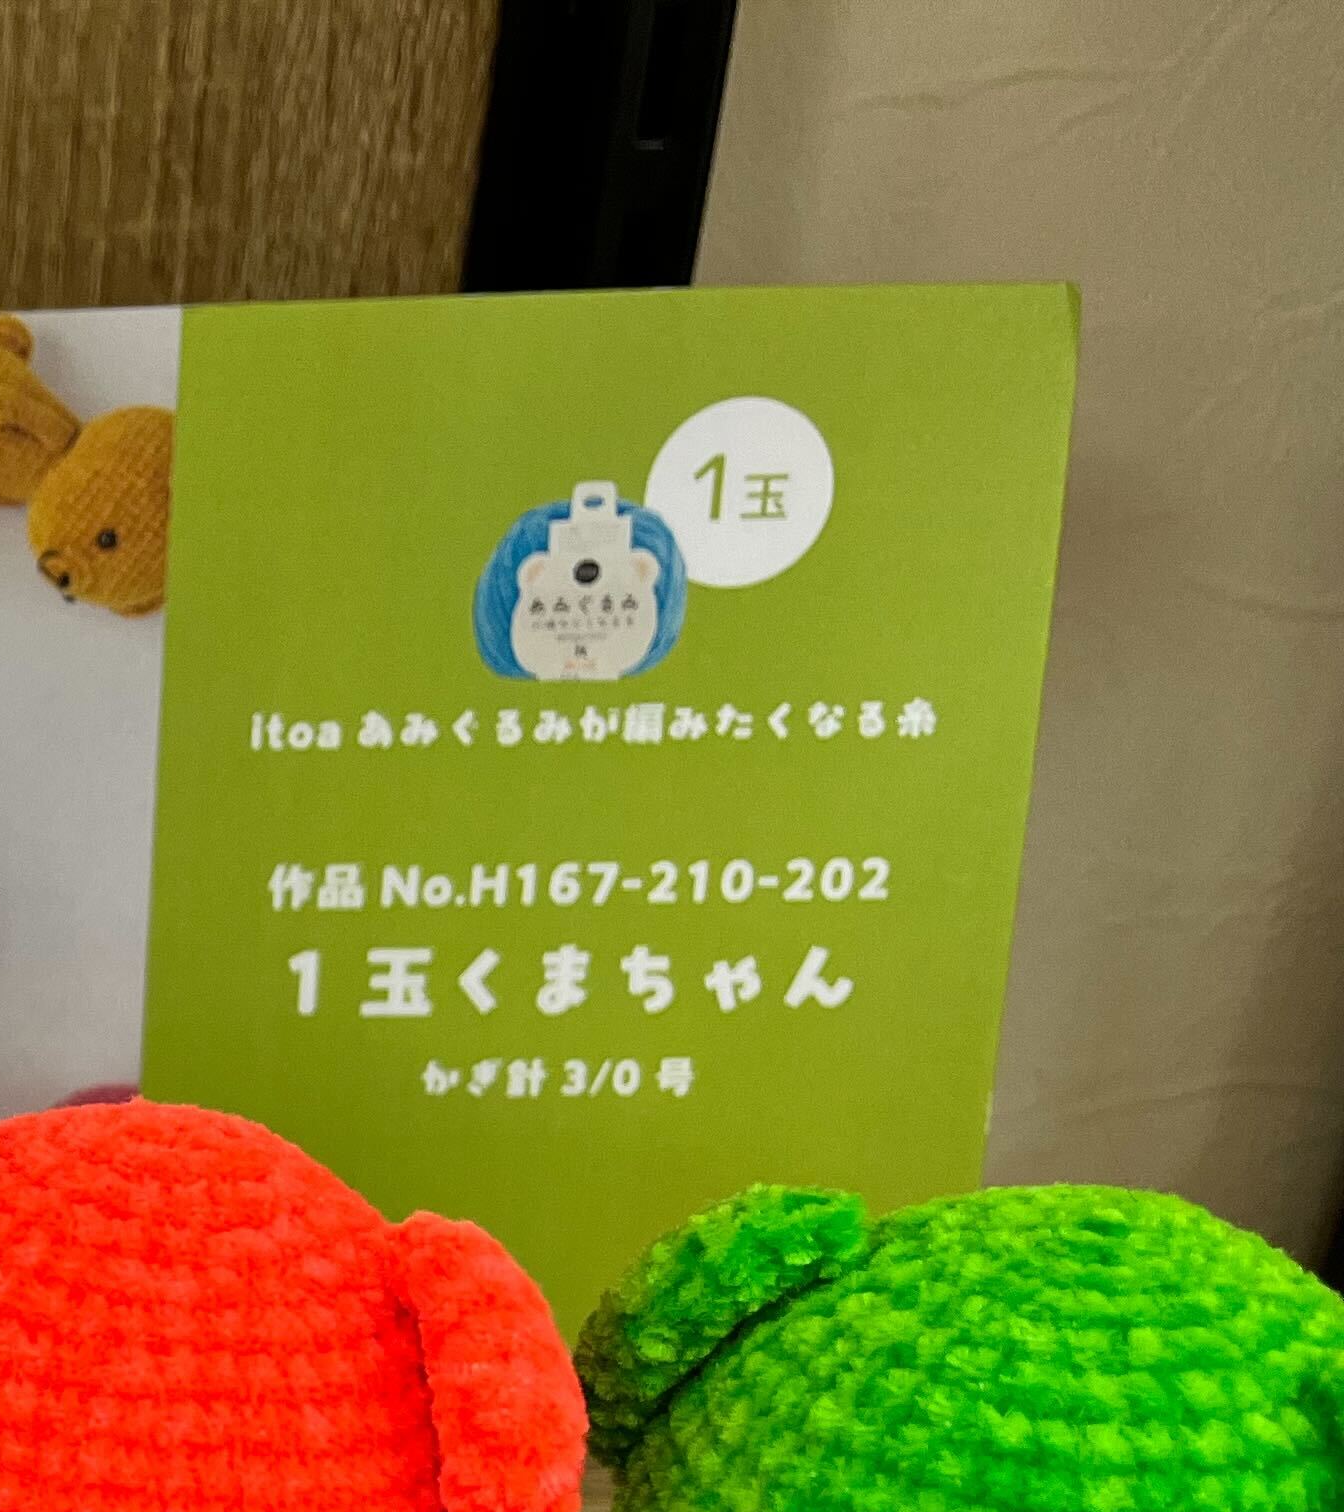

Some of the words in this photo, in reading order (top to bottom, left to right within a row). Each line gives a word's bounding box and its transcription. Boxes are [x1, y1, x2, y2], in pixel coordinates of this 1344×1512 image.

[694, 452, 789, 521] 1玉
[268, 863, 365, 911] 作品
[379, 857, 890, 908] No.H167-210-202
